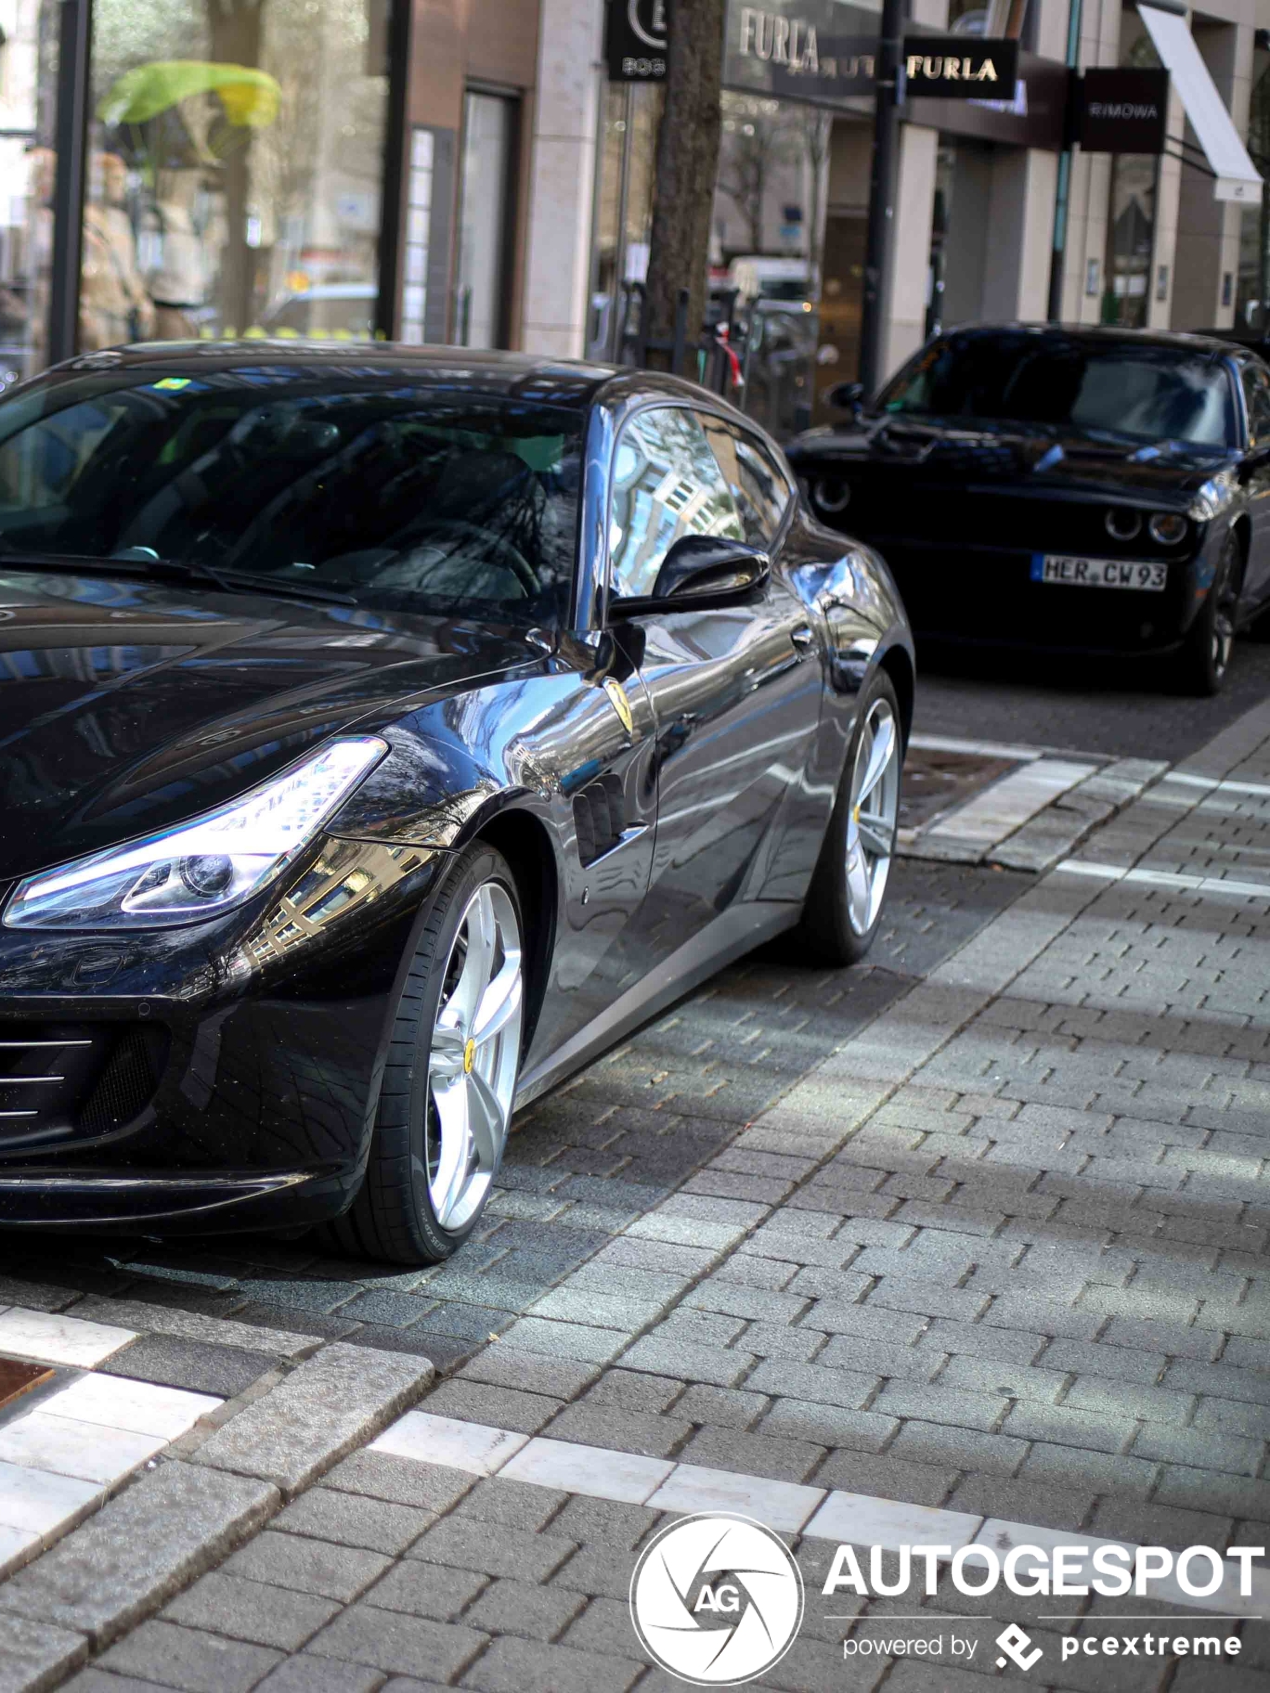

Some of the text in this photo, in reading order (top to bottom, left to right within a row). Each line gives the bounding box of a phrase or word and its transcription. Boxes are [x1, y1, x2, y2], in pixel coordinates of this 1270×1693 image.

[739, 7, 820, 74] FURLA
[622, 57, 667, 76] BOG
[906, 54, 998, 82] FURLA
[1089, 102, 1158, 119] RIMOWA
[1045, 560, 1165, 586] HER CW 93
